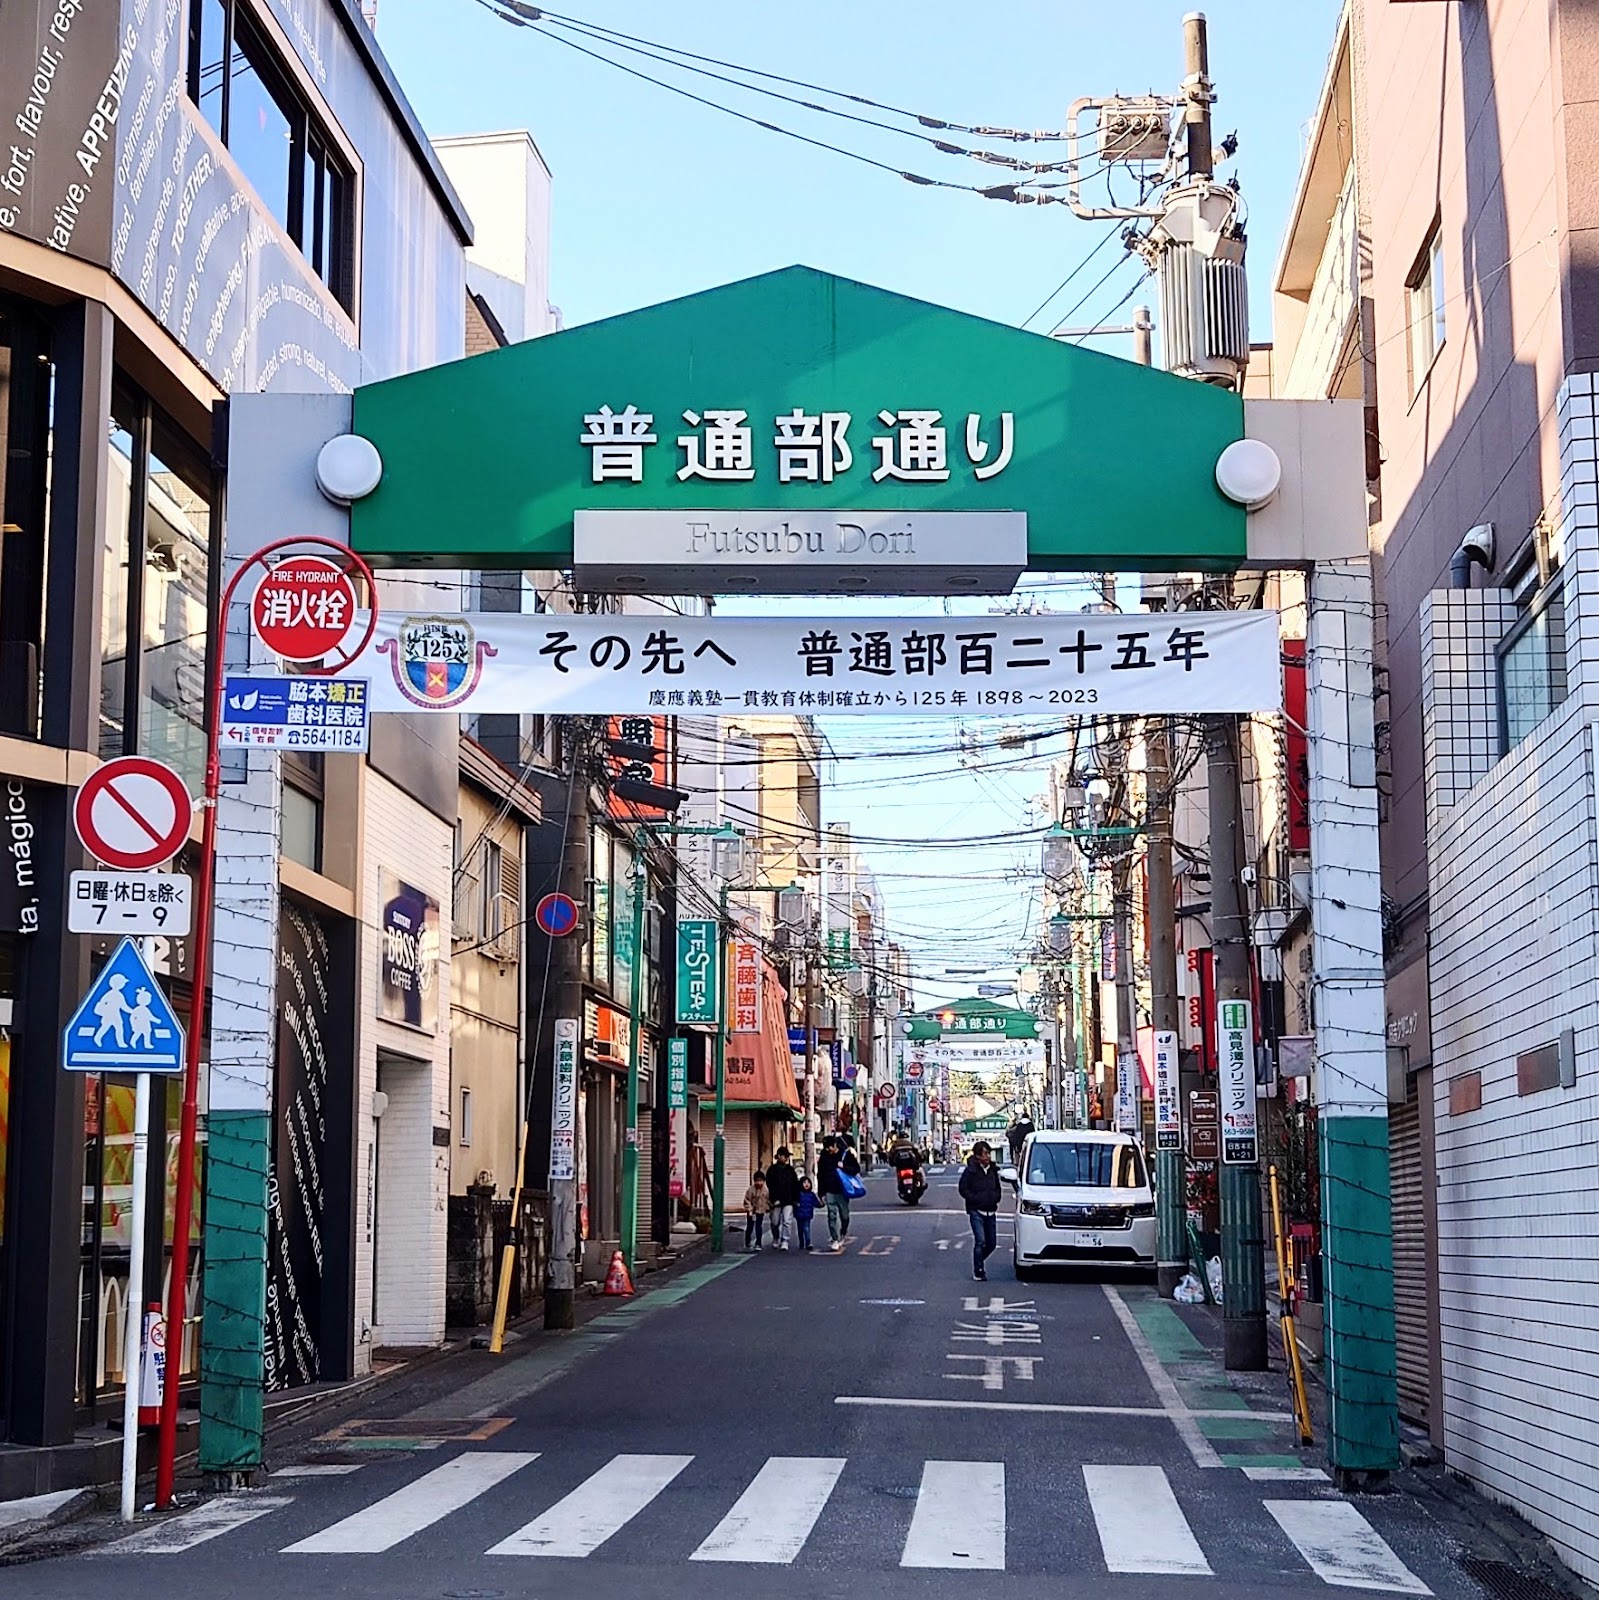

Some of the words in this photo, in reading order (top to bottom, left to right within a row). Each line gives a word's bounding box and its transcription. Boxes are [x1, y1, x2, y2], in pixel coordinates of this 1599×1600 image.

[16, 45, 64, 139] flavour,
[171, 152, 214, 256] TOGETHER,
[580, 405, 1015, 482] 普通部通り
[685, 522, 825, 554] Futsubu
[836, 522, 916, 554] Dori
[272, 571, 293, 582] FIRE
[296, 571, 340, 583] HYDRANT
[261, 588, 347, 629] 消火栓
[422, 639, 452, 657] 125
[538, 630, 738, 676] その先へ
[798, 627, 1210, 677] 普通部百二十五年
[289, 681, 365, 703] 脇本矯正
[287, 704, 363, 726] 歯科医院
[387, 925, 415, 972] BOSS
[390, 967, 412, 992] COFFEE
[284, 1000, 312, 1080] SMILING,
[671, 1041, 685, 1106] 個別指導塾
